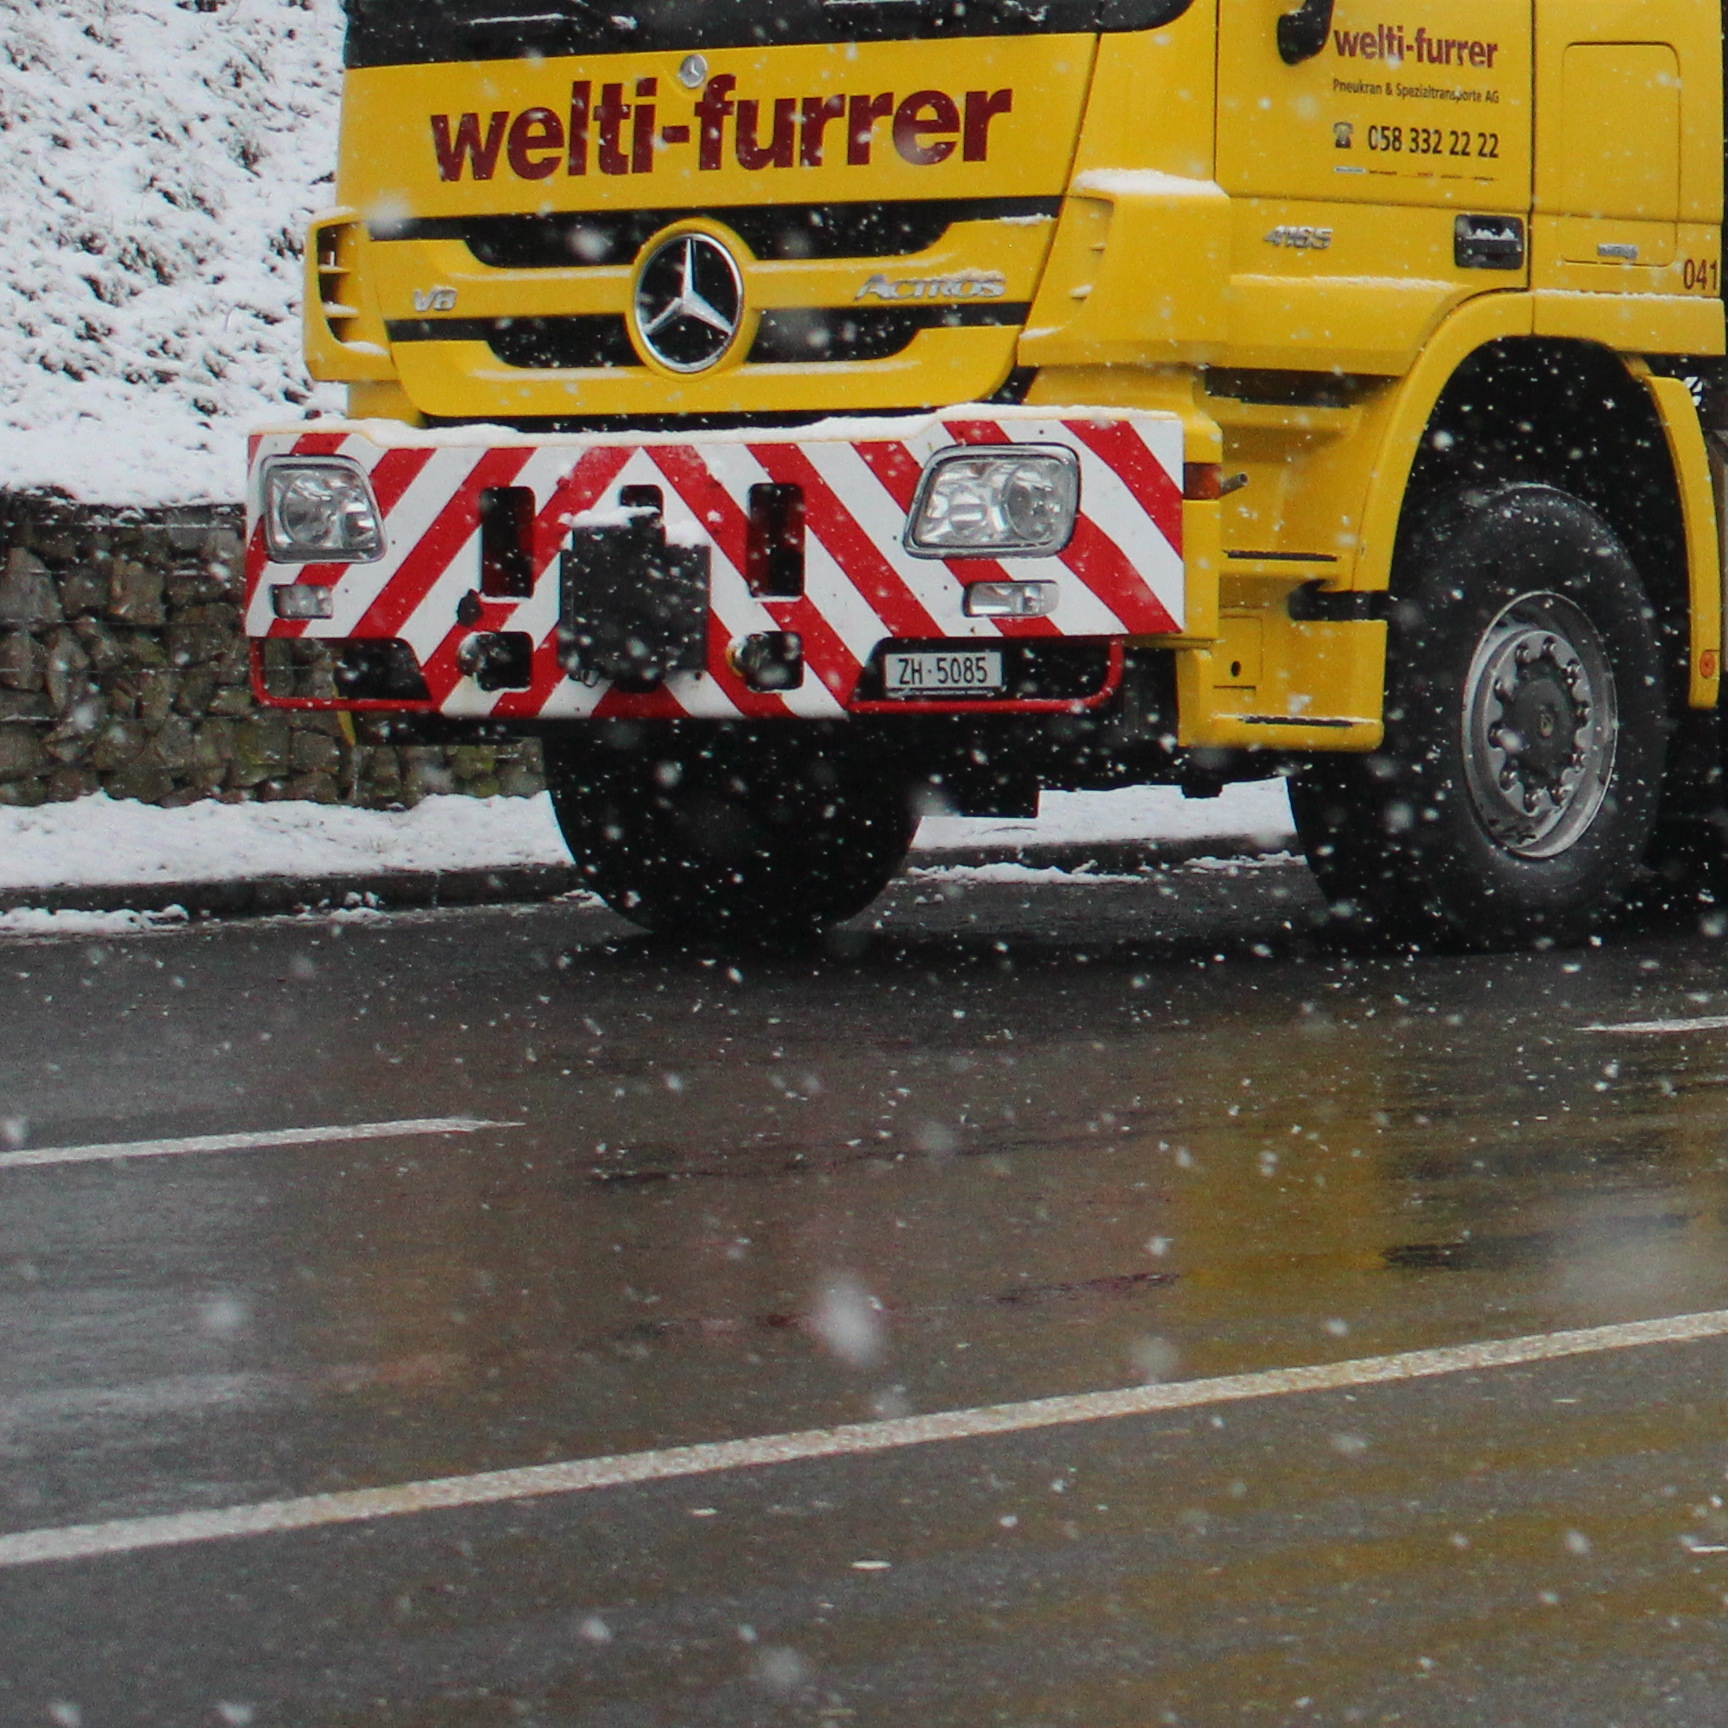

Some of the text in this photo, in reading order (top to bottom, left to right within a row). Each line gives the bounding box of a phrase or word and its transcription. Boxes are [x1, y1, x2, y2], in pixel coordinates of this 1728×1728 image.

[1334, 24, 1498, 68] welti-furrer
[1334, 79, 1499, 103] Pneukran & Spezialtransporte AG
[431, 74, 1012, 181] welti-furrer
[1368, 125, 1499, 158] 058 332 22 22
[1683, 259, 1718, 290] 041
